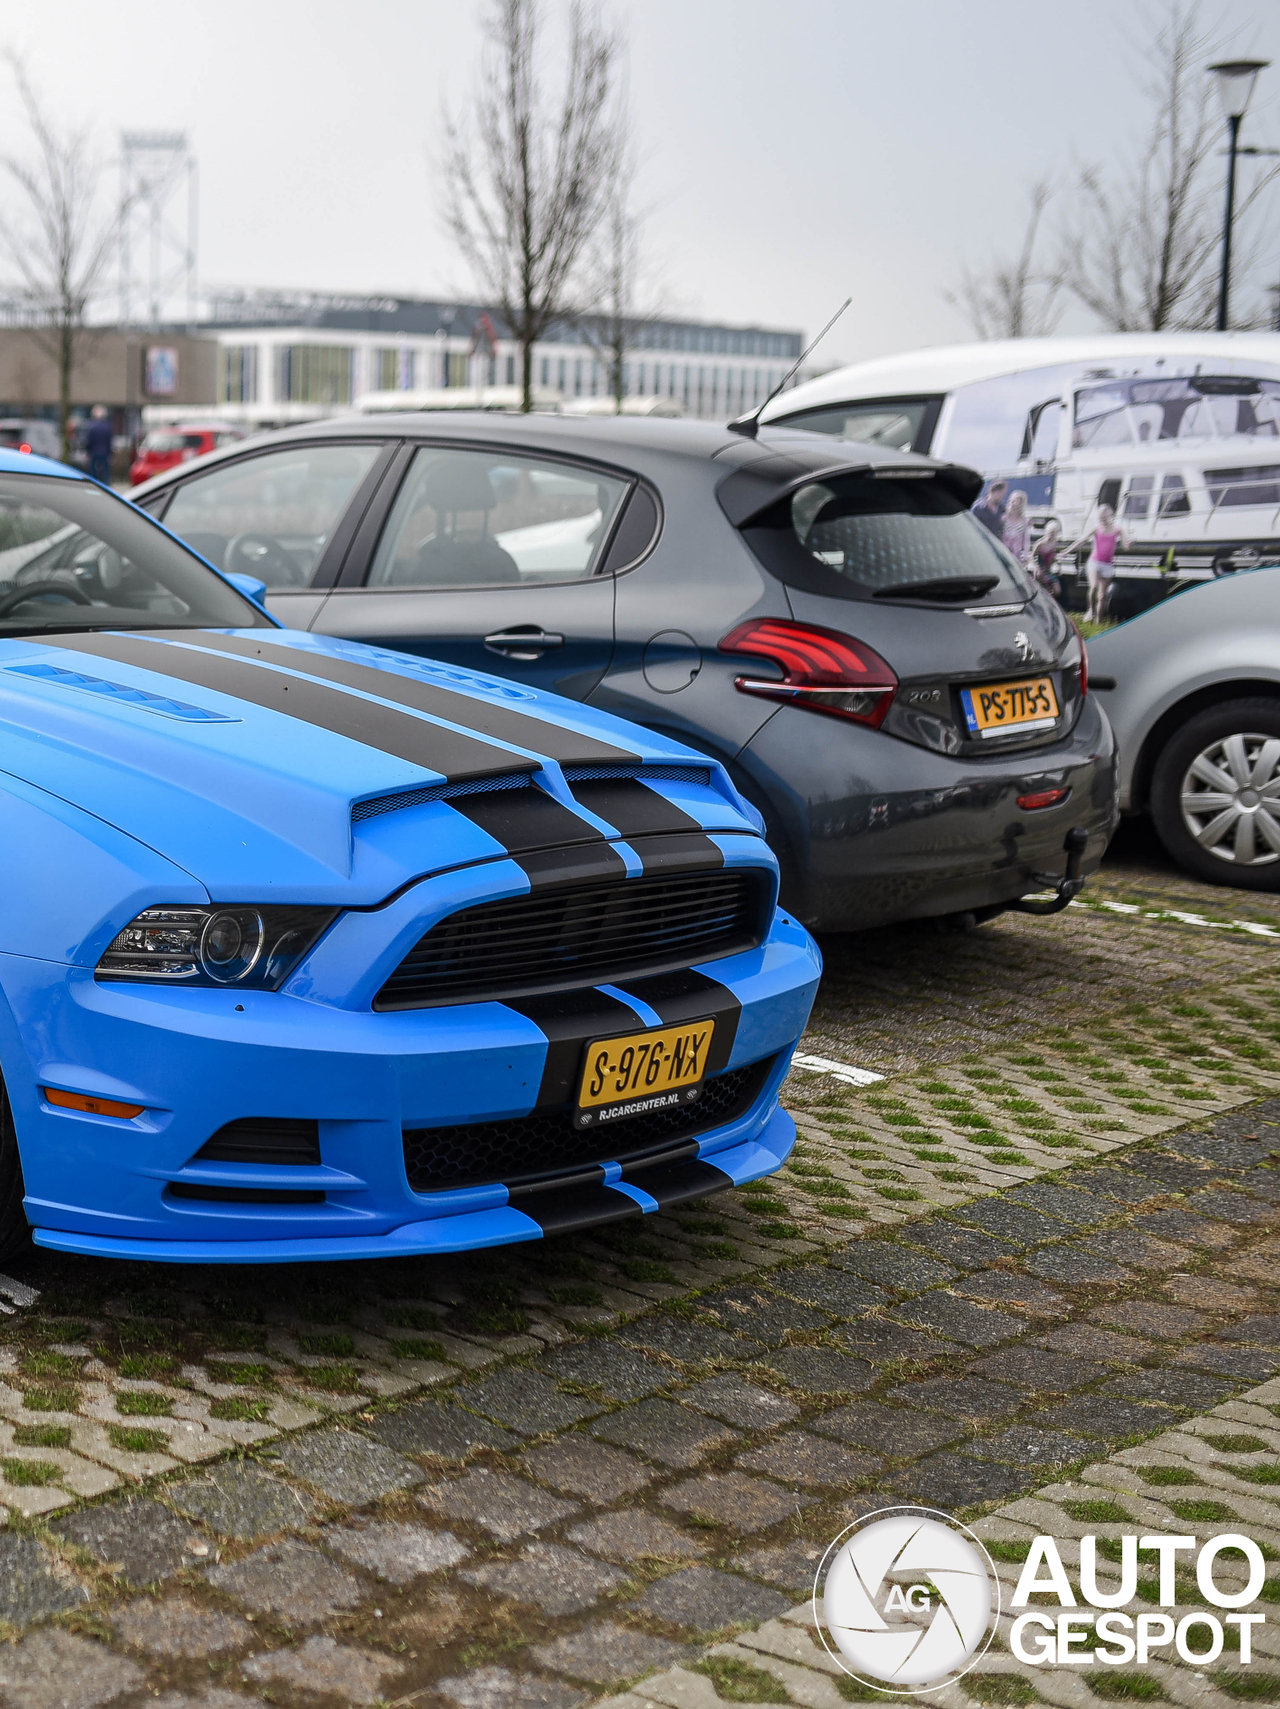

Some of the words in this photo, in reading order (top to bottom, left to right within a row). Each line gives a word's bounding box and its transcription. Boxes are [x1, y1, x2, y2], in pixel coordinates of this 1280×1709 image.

[980, 684, 1051, 722] PS-775-S
[590, 1031, 707, 1097] S-976-NX
[599, 1093, 680, 1121] RJCARCENTER.NL
